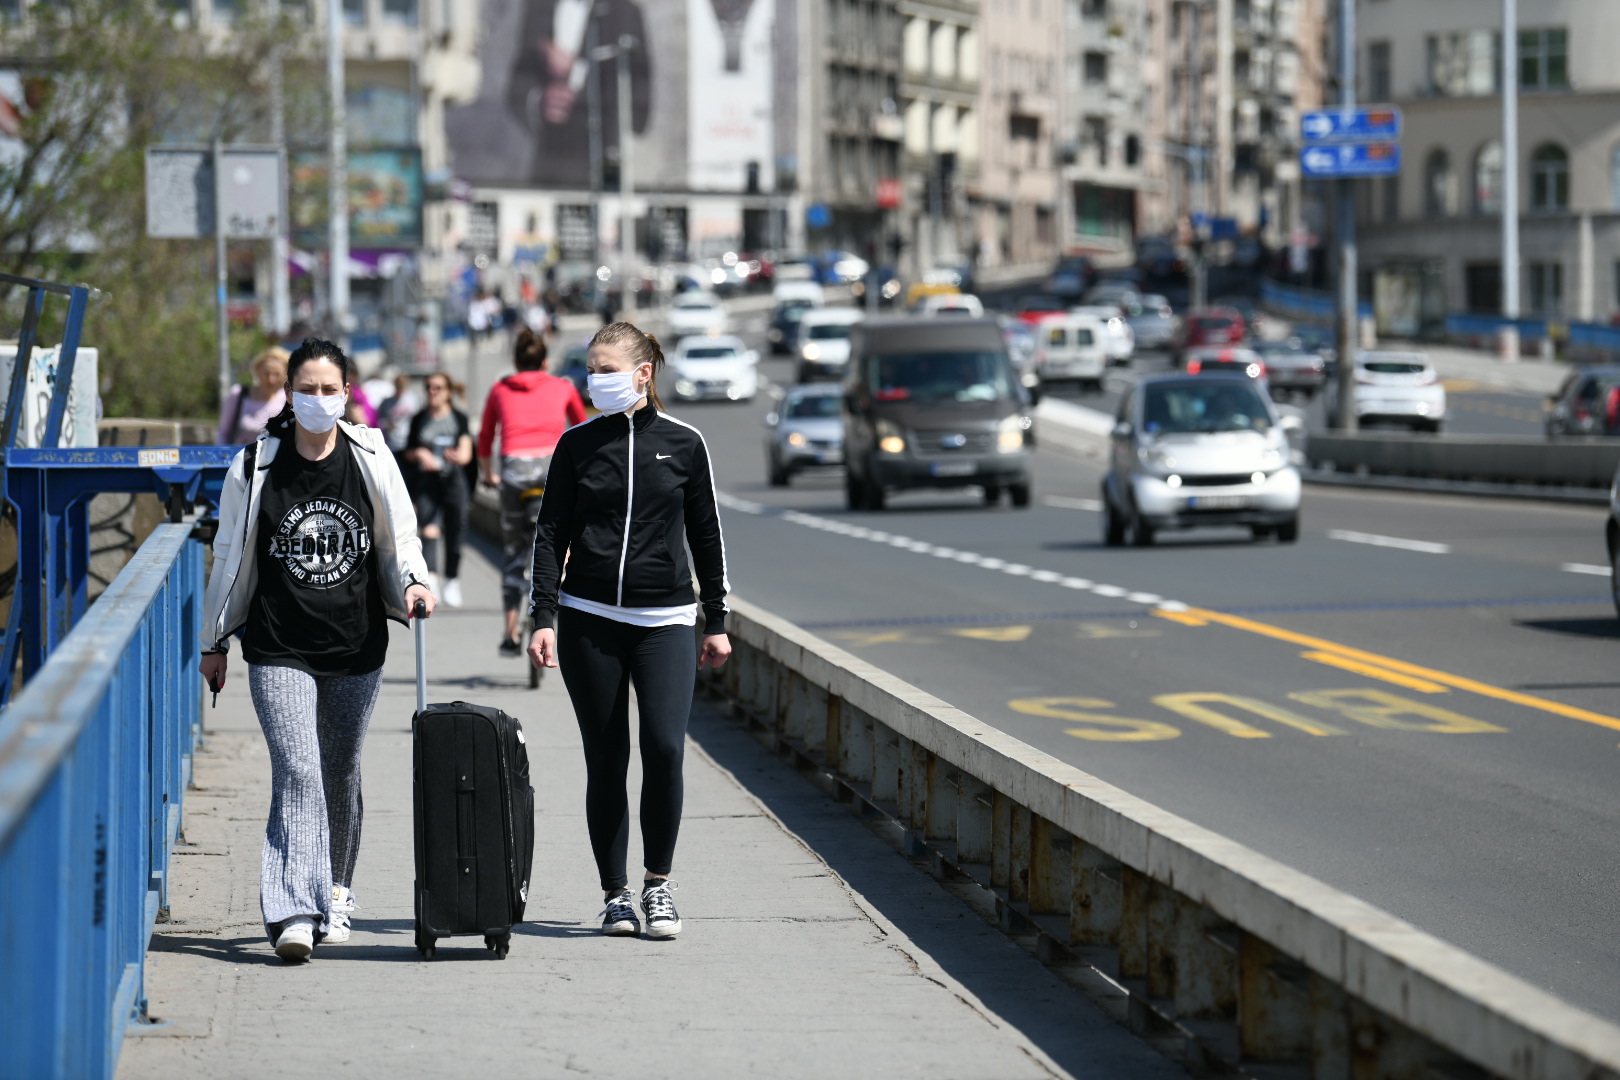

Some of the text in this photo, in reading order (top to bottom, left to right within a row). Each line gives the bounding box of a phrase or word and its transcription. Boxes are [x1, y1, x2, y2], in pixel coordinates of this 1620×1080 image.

[280, 500, 359, 535] SAMO JEDAN KLUB
[276, 529, 367, 557] BEOGRAD
[286, 551, 358, 584] SAMO JEDAN GRAD
[1008, 688, 1509, 742] BUS
